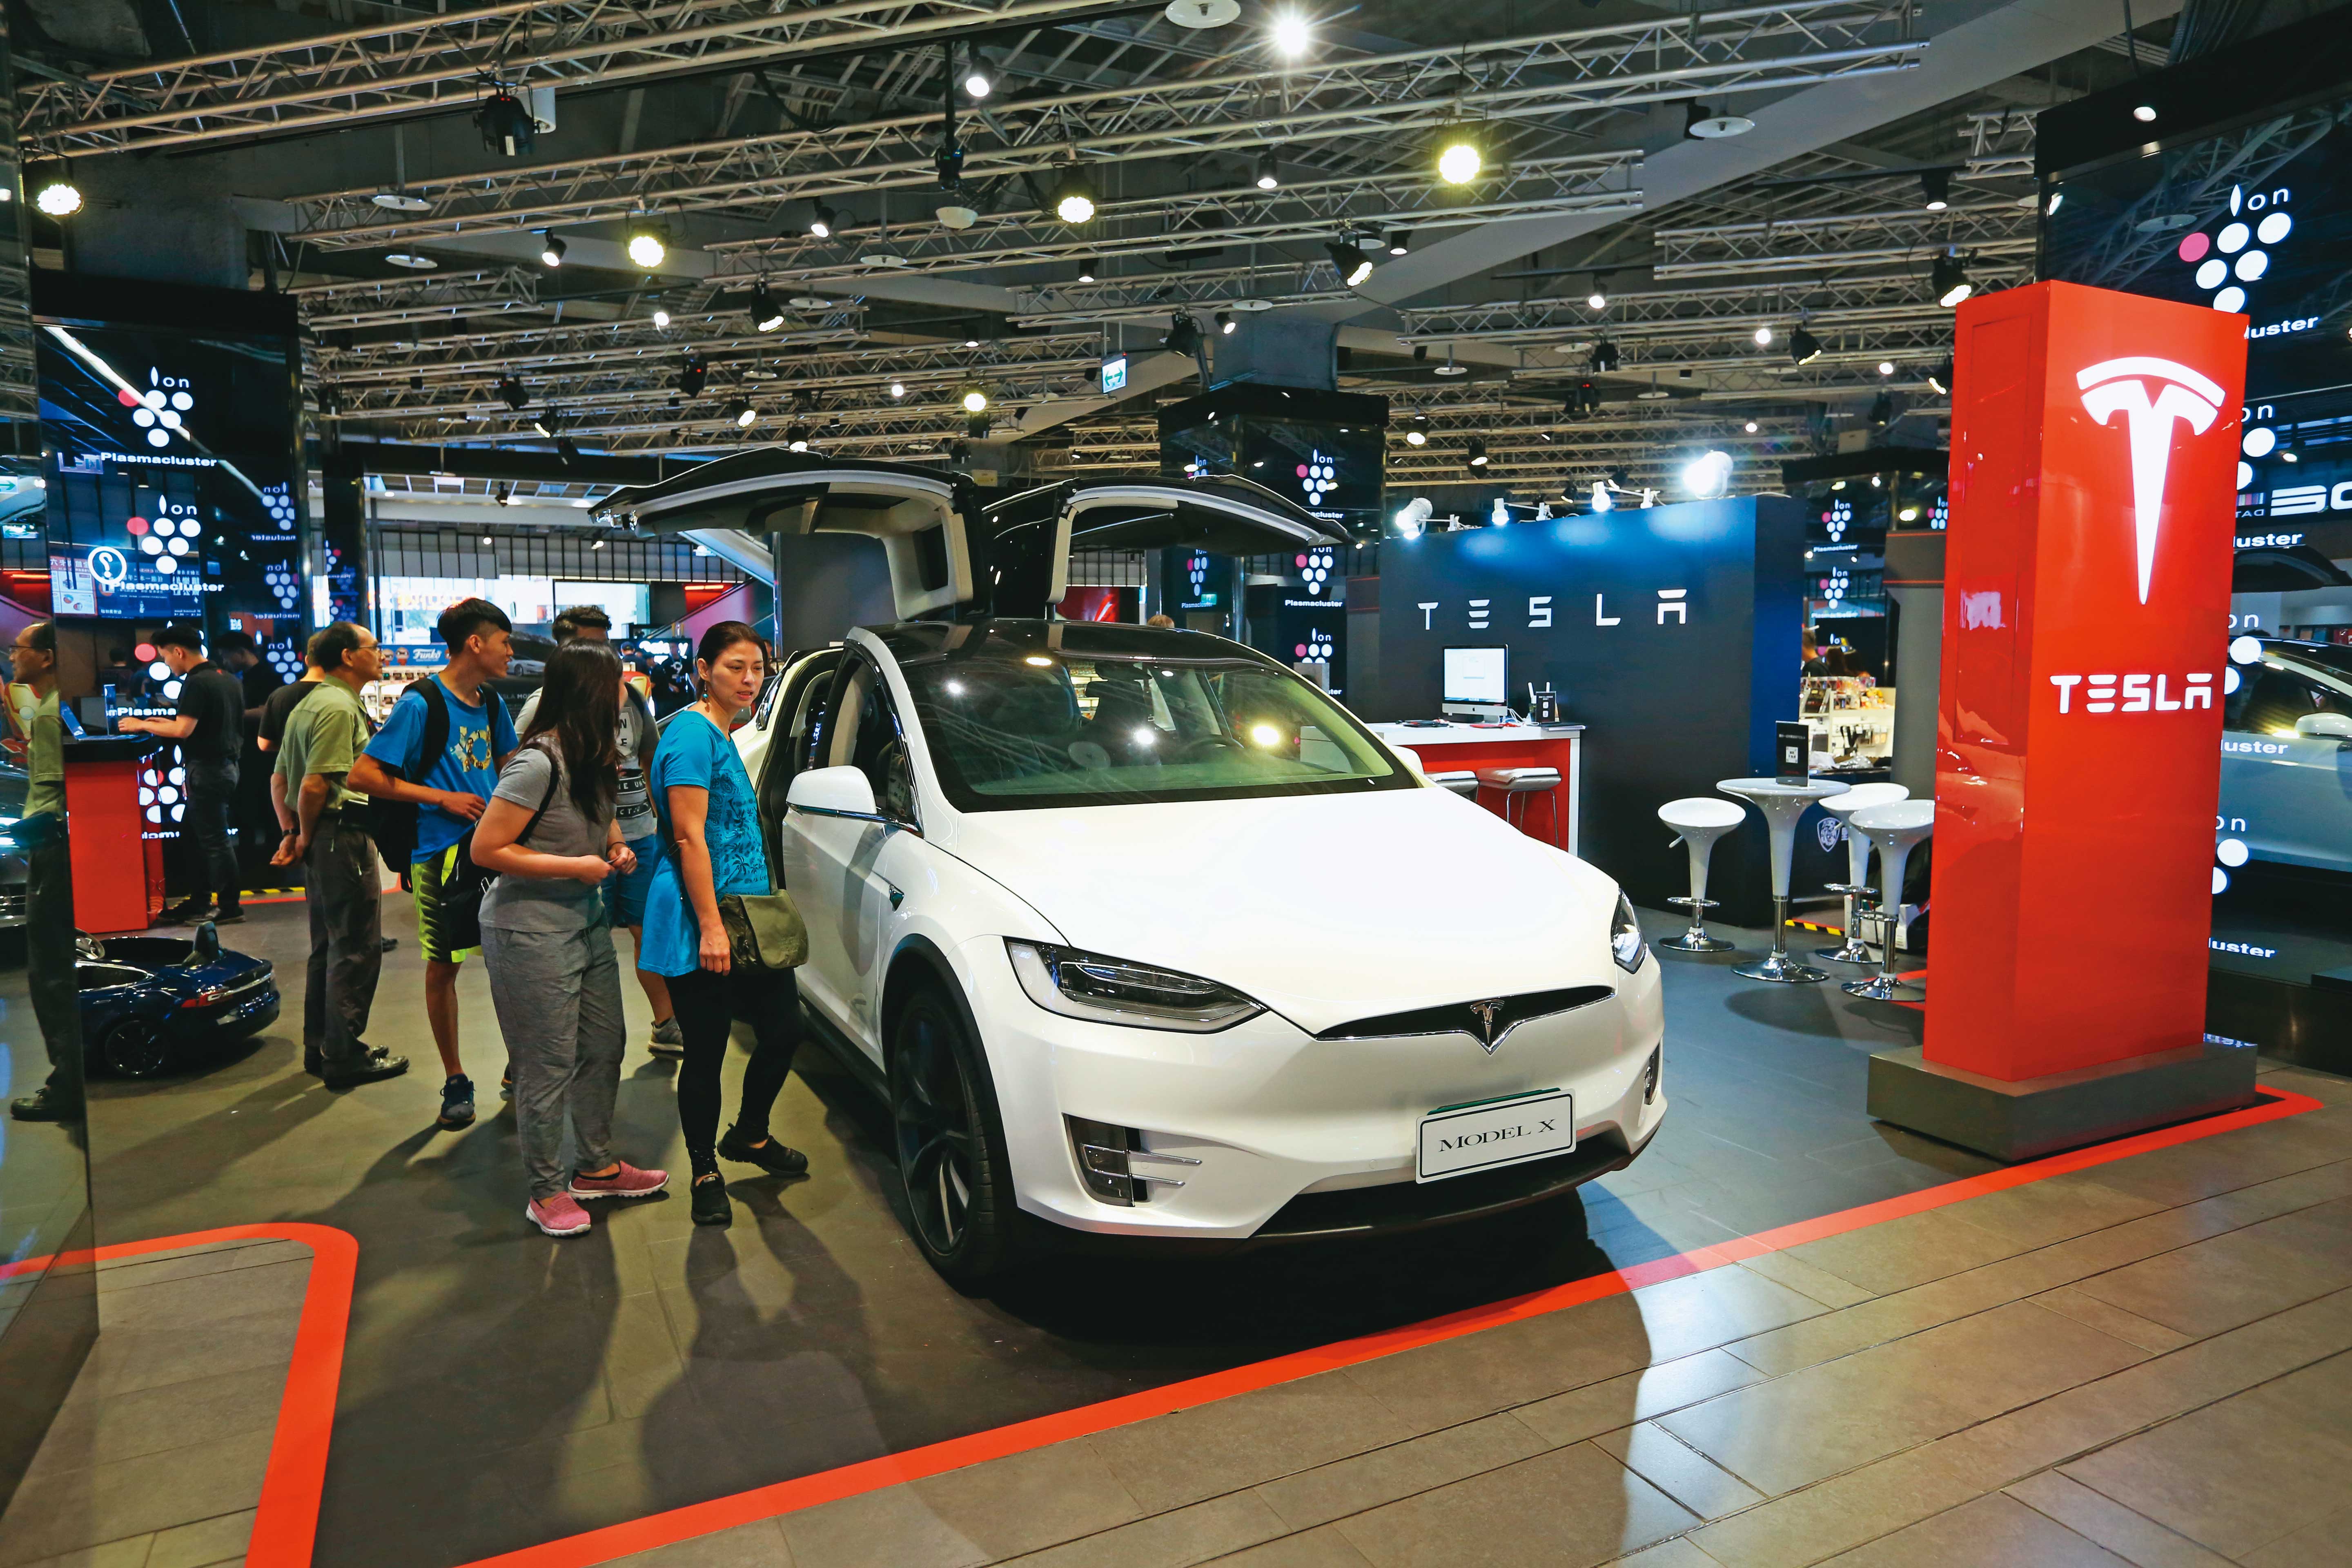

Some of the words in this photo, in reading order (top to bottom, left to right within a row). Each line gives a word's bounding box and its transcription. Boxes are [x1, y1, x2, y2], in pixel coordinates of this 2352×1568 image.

[101, 452, 217, 466] Plasmacluster
[110, 581, 224, 592] Plasmacluster
[1417, 588, 1687, 630] TESLA
[413, 648, 442, 659] Funko
[2049, 673, 2213, 714] TESLA
[1439, 1125, 1531, 1152] MODEL
[1538, 1119, 1555, 1133] X
